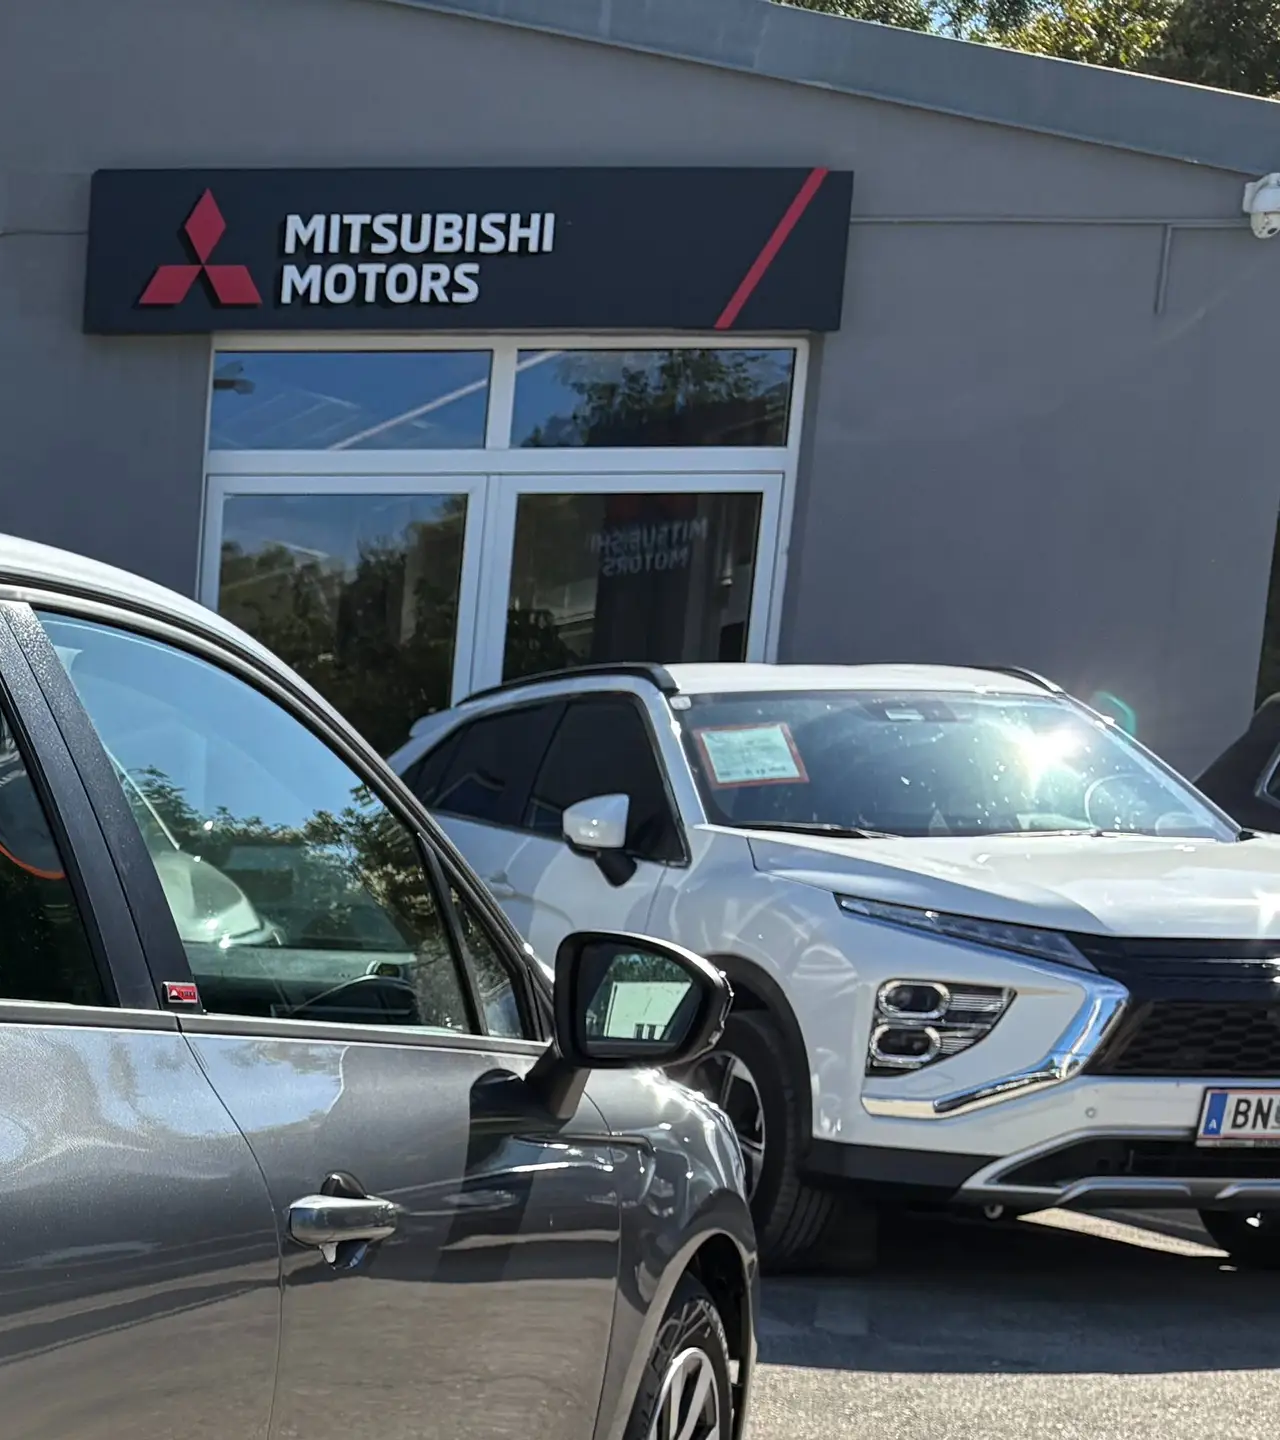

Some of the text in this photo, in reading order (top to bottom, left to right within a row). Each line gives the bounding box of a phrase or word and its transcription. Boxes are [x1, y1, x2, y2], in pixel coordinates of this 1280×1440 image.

[284, 212, 556, 255] MITSUBISHI
[280, 262, 481, 305] MOTORS
[1208, 1118, 1217, 1131] A
